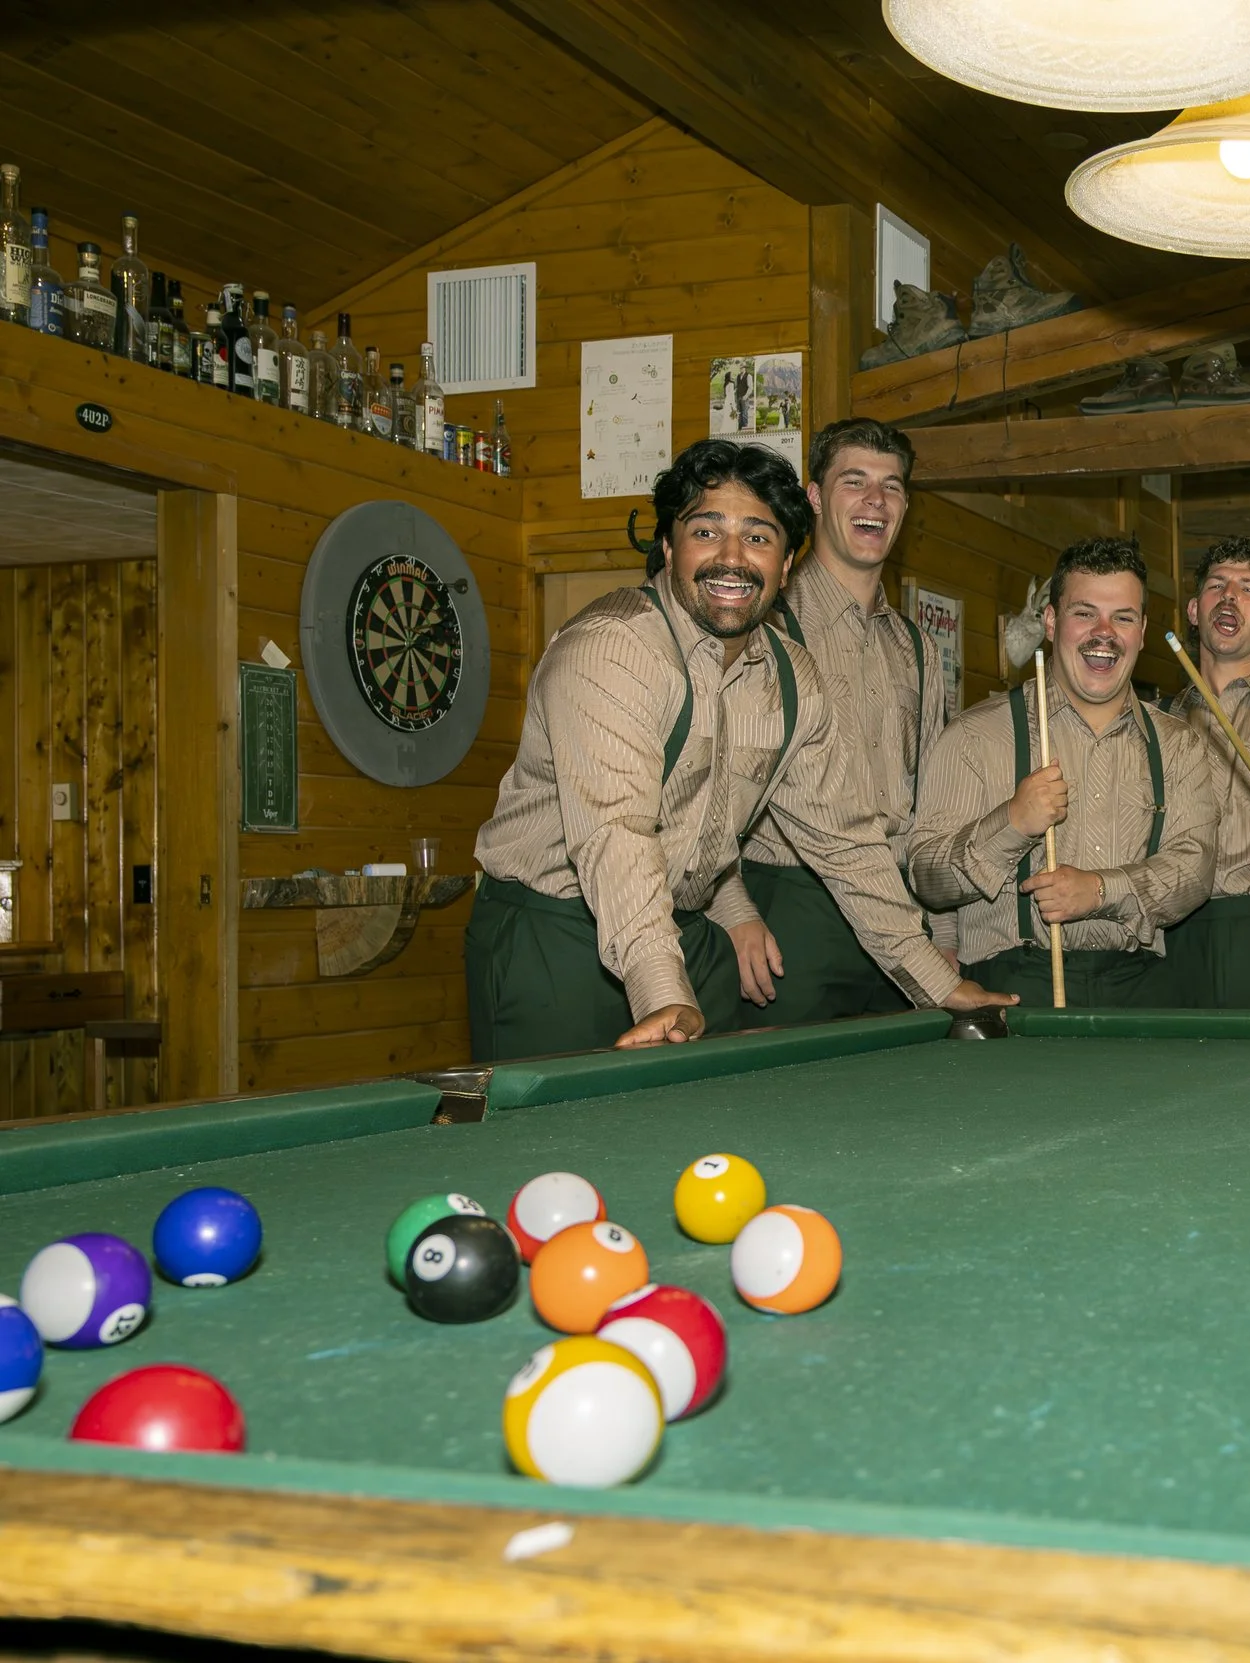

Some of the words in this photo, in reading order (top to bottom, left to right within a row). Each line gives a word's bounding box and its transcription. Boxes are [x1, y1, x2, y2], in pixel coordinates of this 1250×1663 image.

[82, 408, 109, 427] 4U2P
[387, 562, 428, 581] WINMAU
[703, 1161, 720, 1169] 1
[423, 1248, 444, 1264] 8
